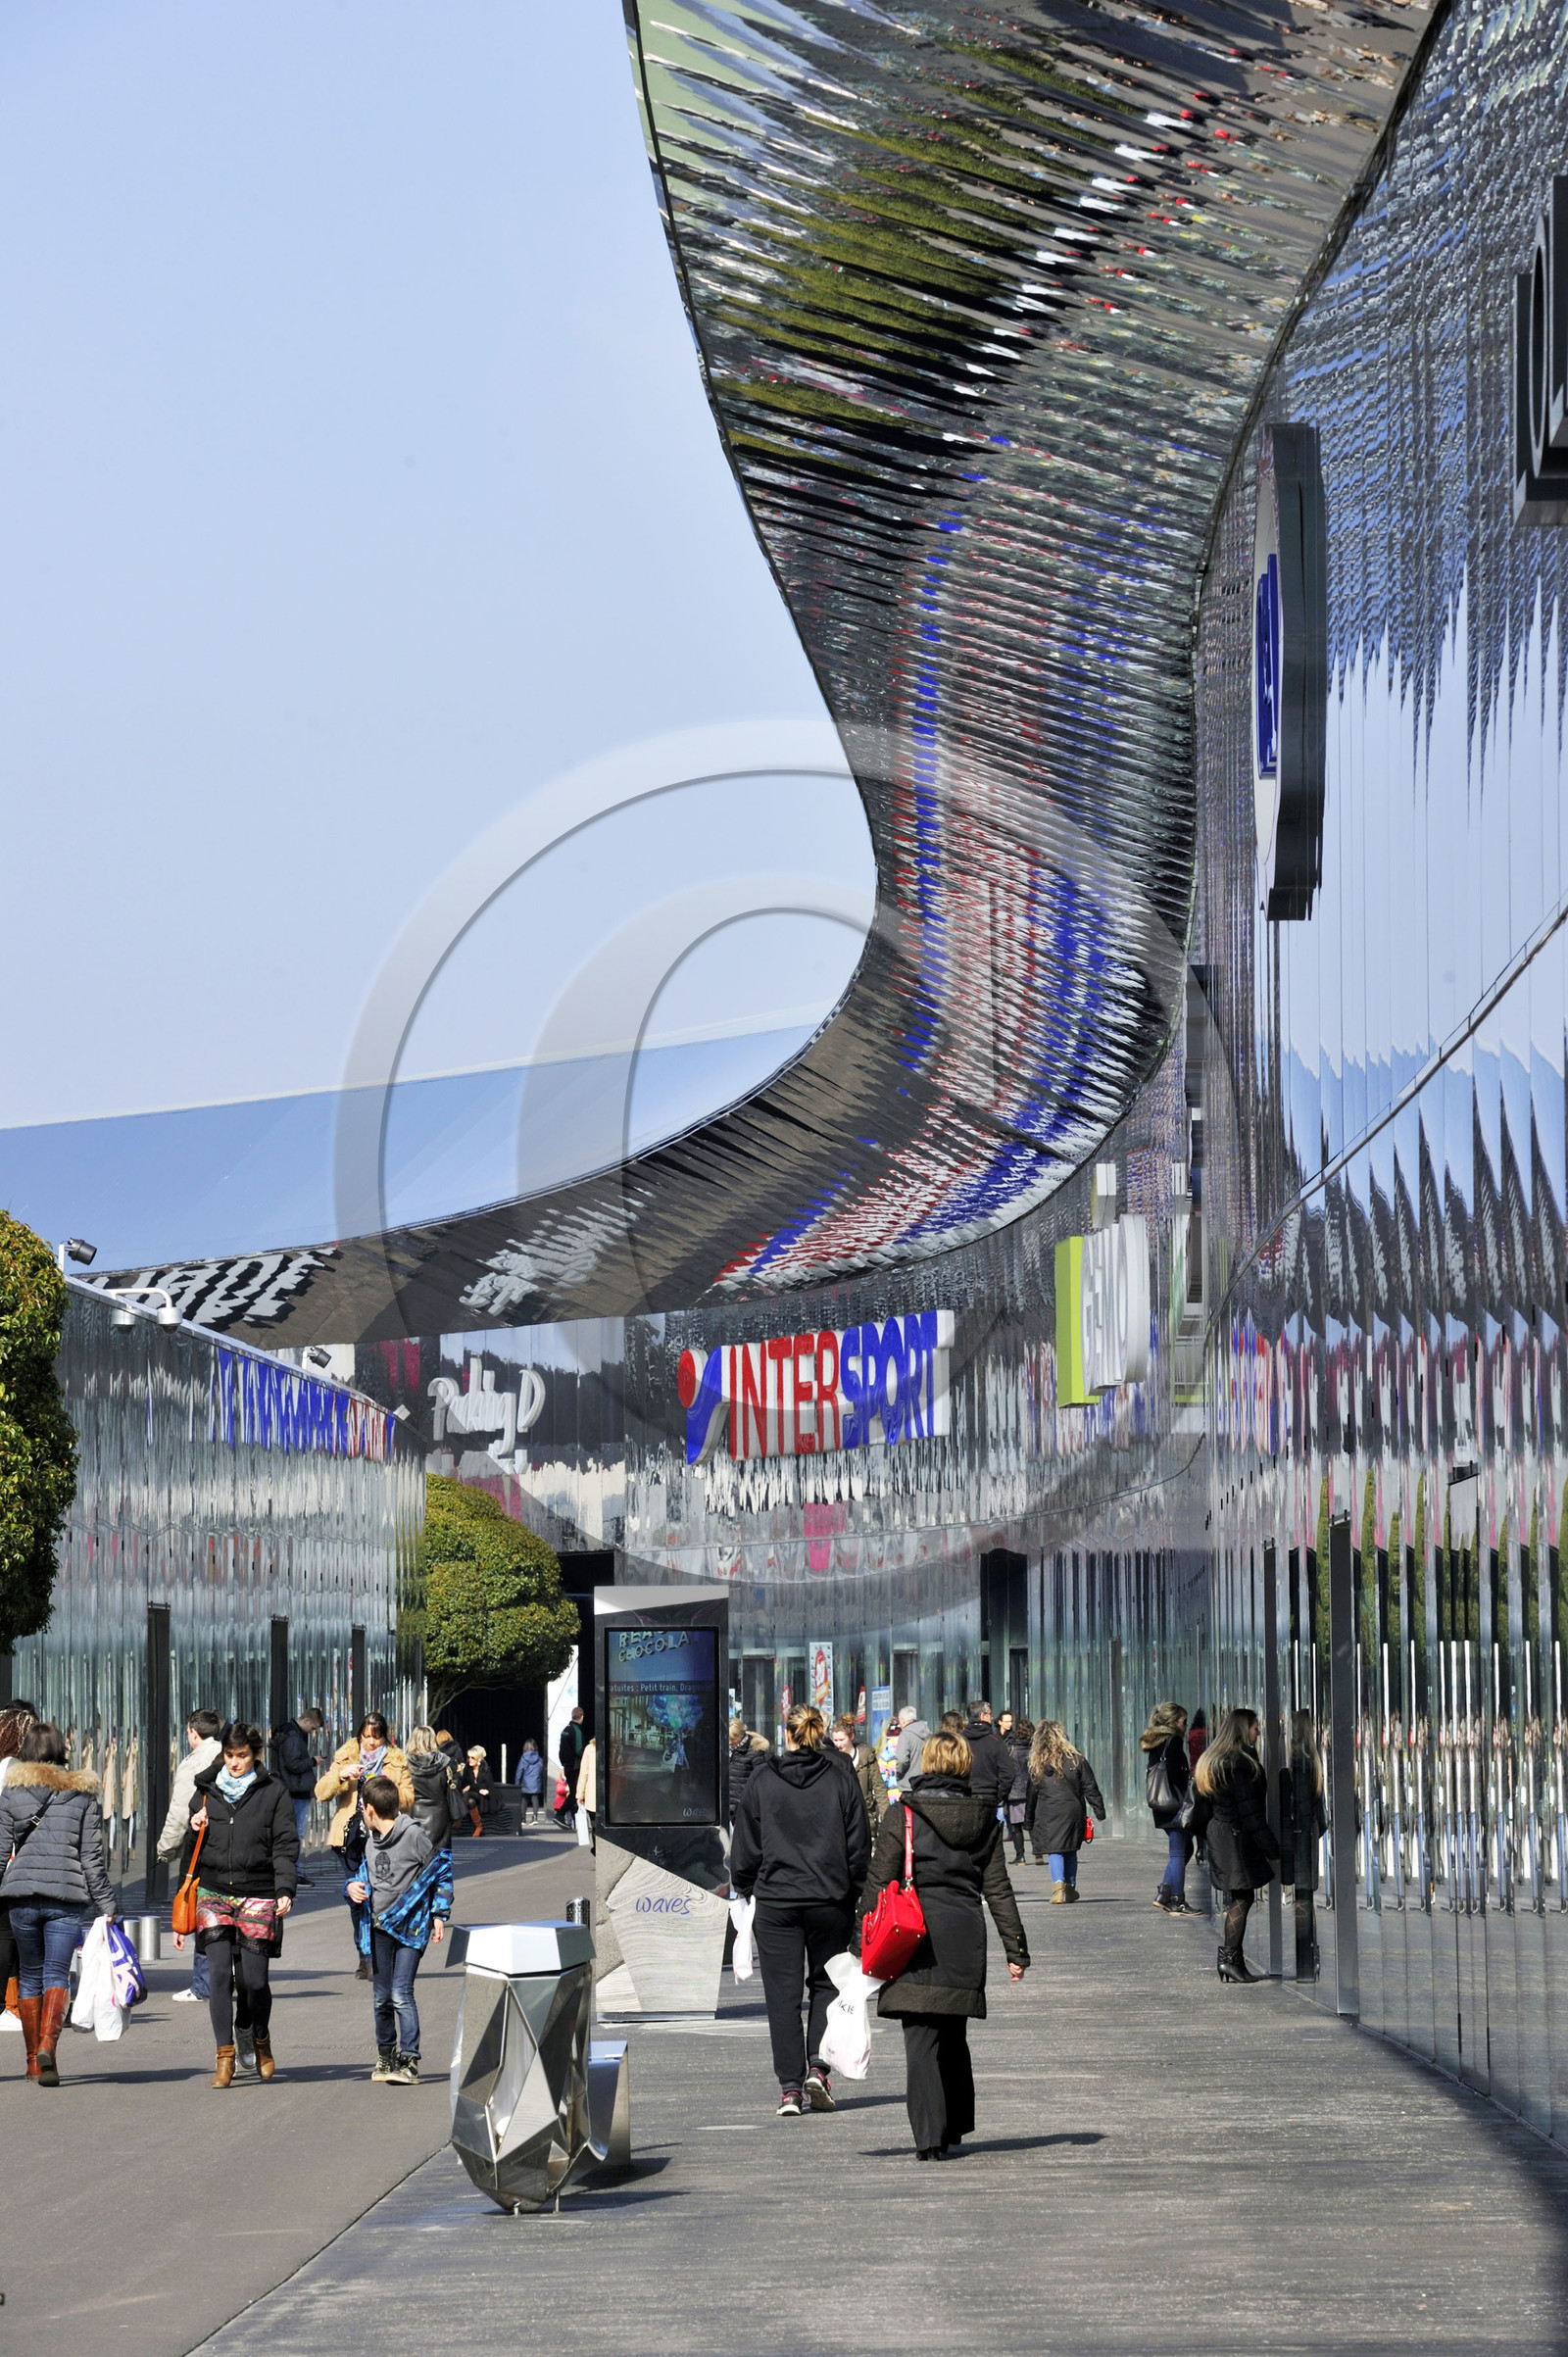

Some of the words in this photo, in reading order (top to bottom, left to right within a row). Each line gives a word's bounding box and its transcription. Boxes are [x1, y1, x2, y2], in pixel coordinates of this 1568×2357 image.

[1513, 173, 1568, 526] LOL
[427, 1357, 516, 1458] Parking
[516, 1369, 546, 1433] D
[729, 1309, 955, 1461] INTERSPORT
[640, 1683, 658, 1693] Petit
[635, 1896, 692, 1915] waves
